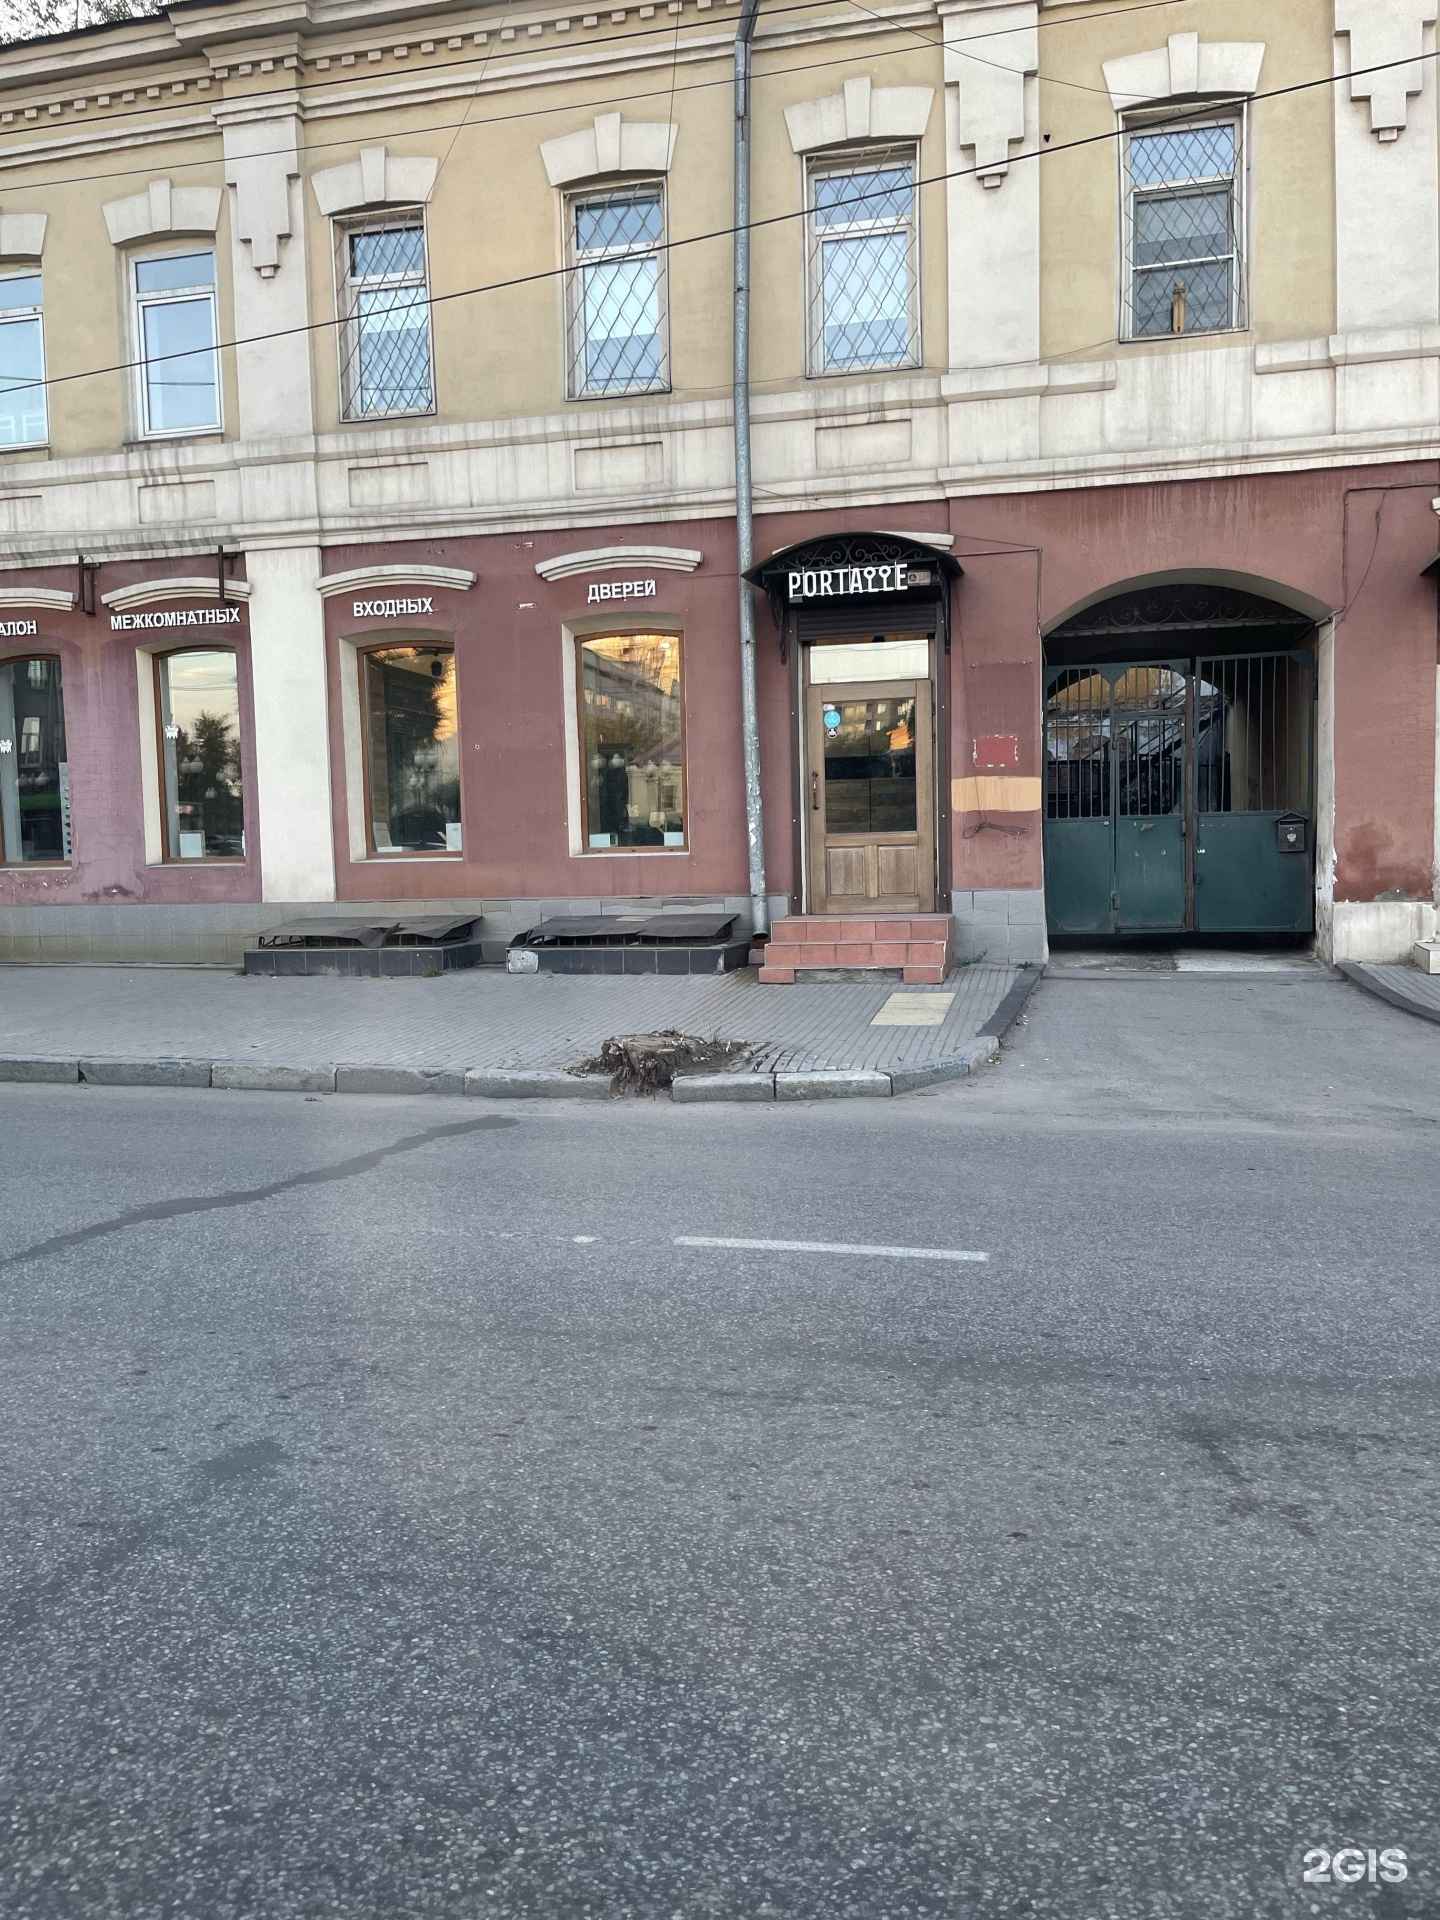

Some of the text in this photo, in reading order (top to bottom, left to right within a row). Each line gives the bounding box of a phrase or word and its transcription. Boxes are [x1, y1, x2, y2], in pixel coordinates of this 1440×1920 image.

[788, 563, 908, 598] PORTALLE
[110, 607, 241, 631] МЕЖКОМНАТНЫХ
[352, 597, 433, 617] ВХОДНЫХ
[587, 579, 656, 602] ДВЕРЕЙ
